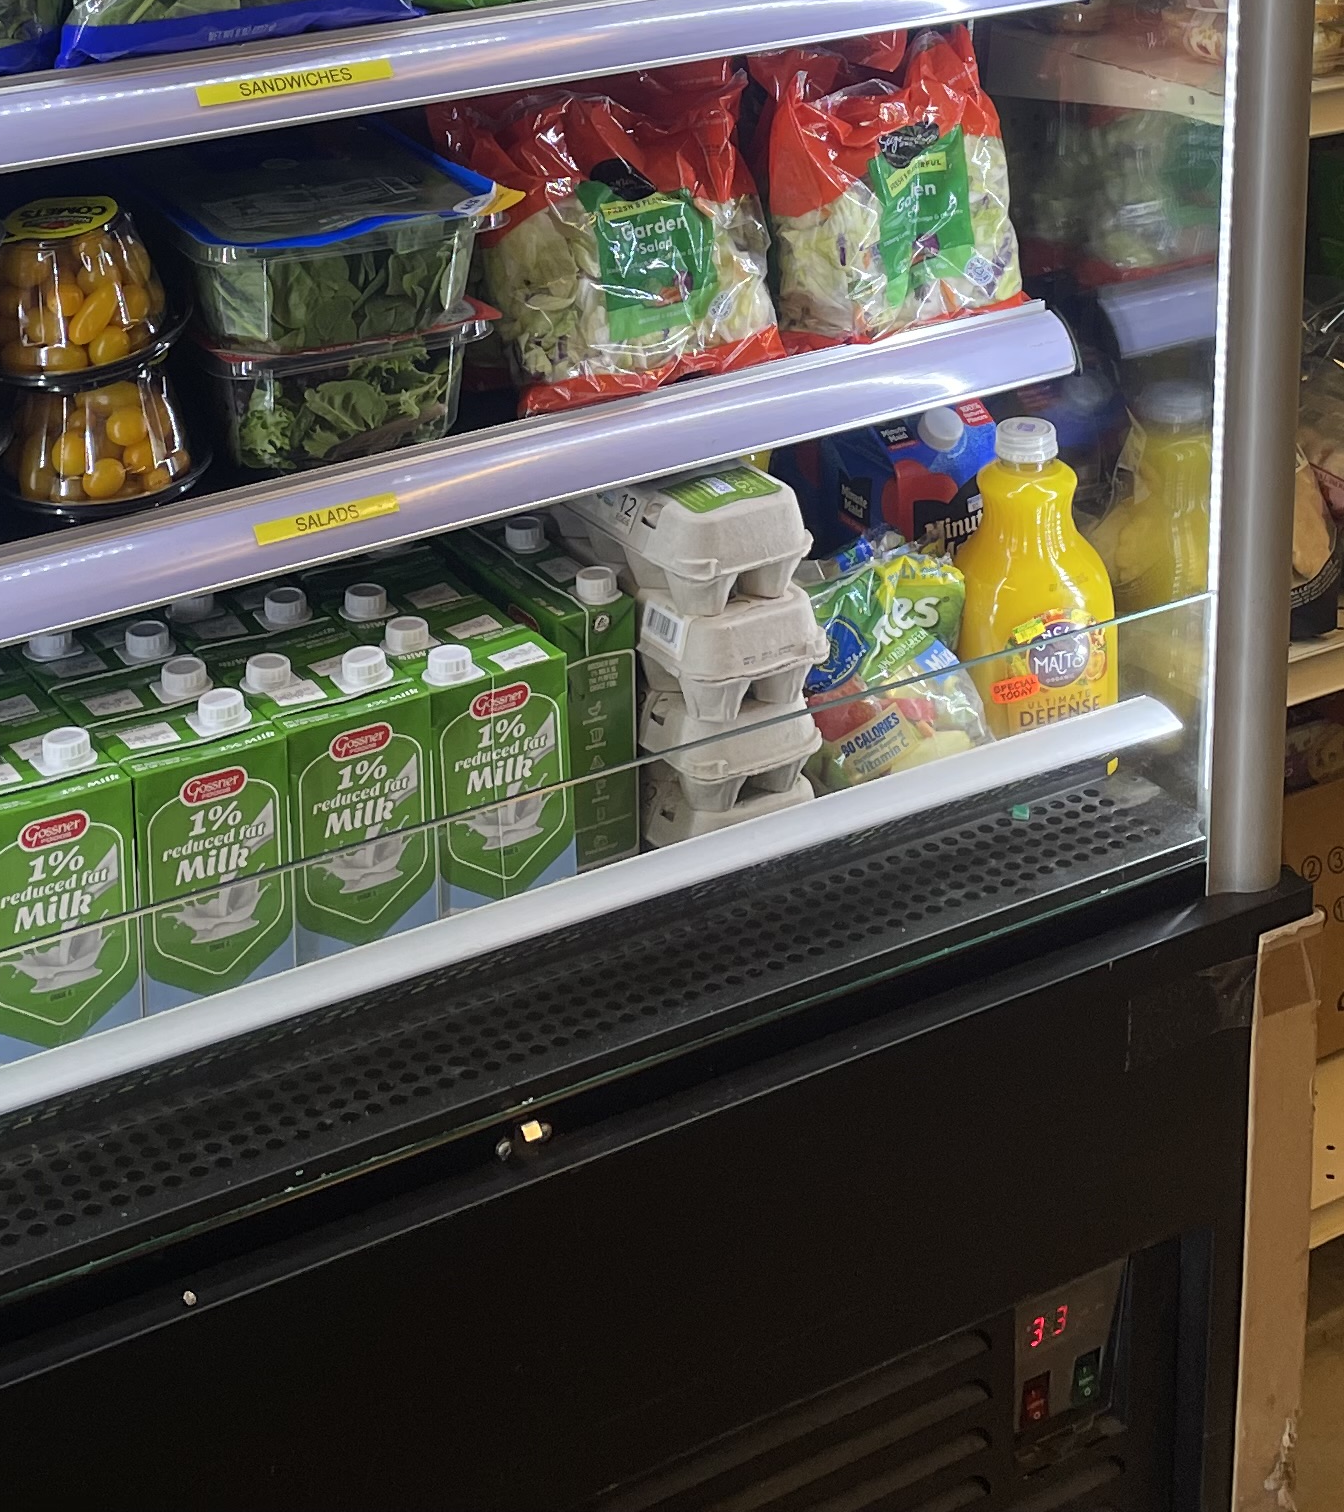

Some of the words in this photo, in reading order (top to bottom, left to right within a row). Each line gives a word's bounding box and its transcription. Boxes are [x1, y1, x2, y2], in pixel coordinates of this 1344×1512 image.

[239, 66, 354, 98] SANDWICHES
[621, 215, 687, 242] Garden
[637, 236, 673, 255] Salad
[295, 504, 361, 532] SALADS
[993, 677, 1037, 695] SPECIAL
[1000, 687, 1033, 702] TODAY
[1027, 688, 1091, 710] ULTIMATE
[1019, 694, 1102, 728] DEFENSE
[855, 711, 901, 749] CALORIES
[24, 817, 82, 848] Gossner
[188, 800, 244, 837] 1%
[324, 797, 396, 839] Milk
[161, 827, 236, 862] reduced
[28, 845, 85, 883] 1%
[175, 844, 251, 886] Milk
[0, 873, 79, 910] reduced
[13, 890, 94, 934] Milk
[1030, 1304, 1069, 1348] 33
